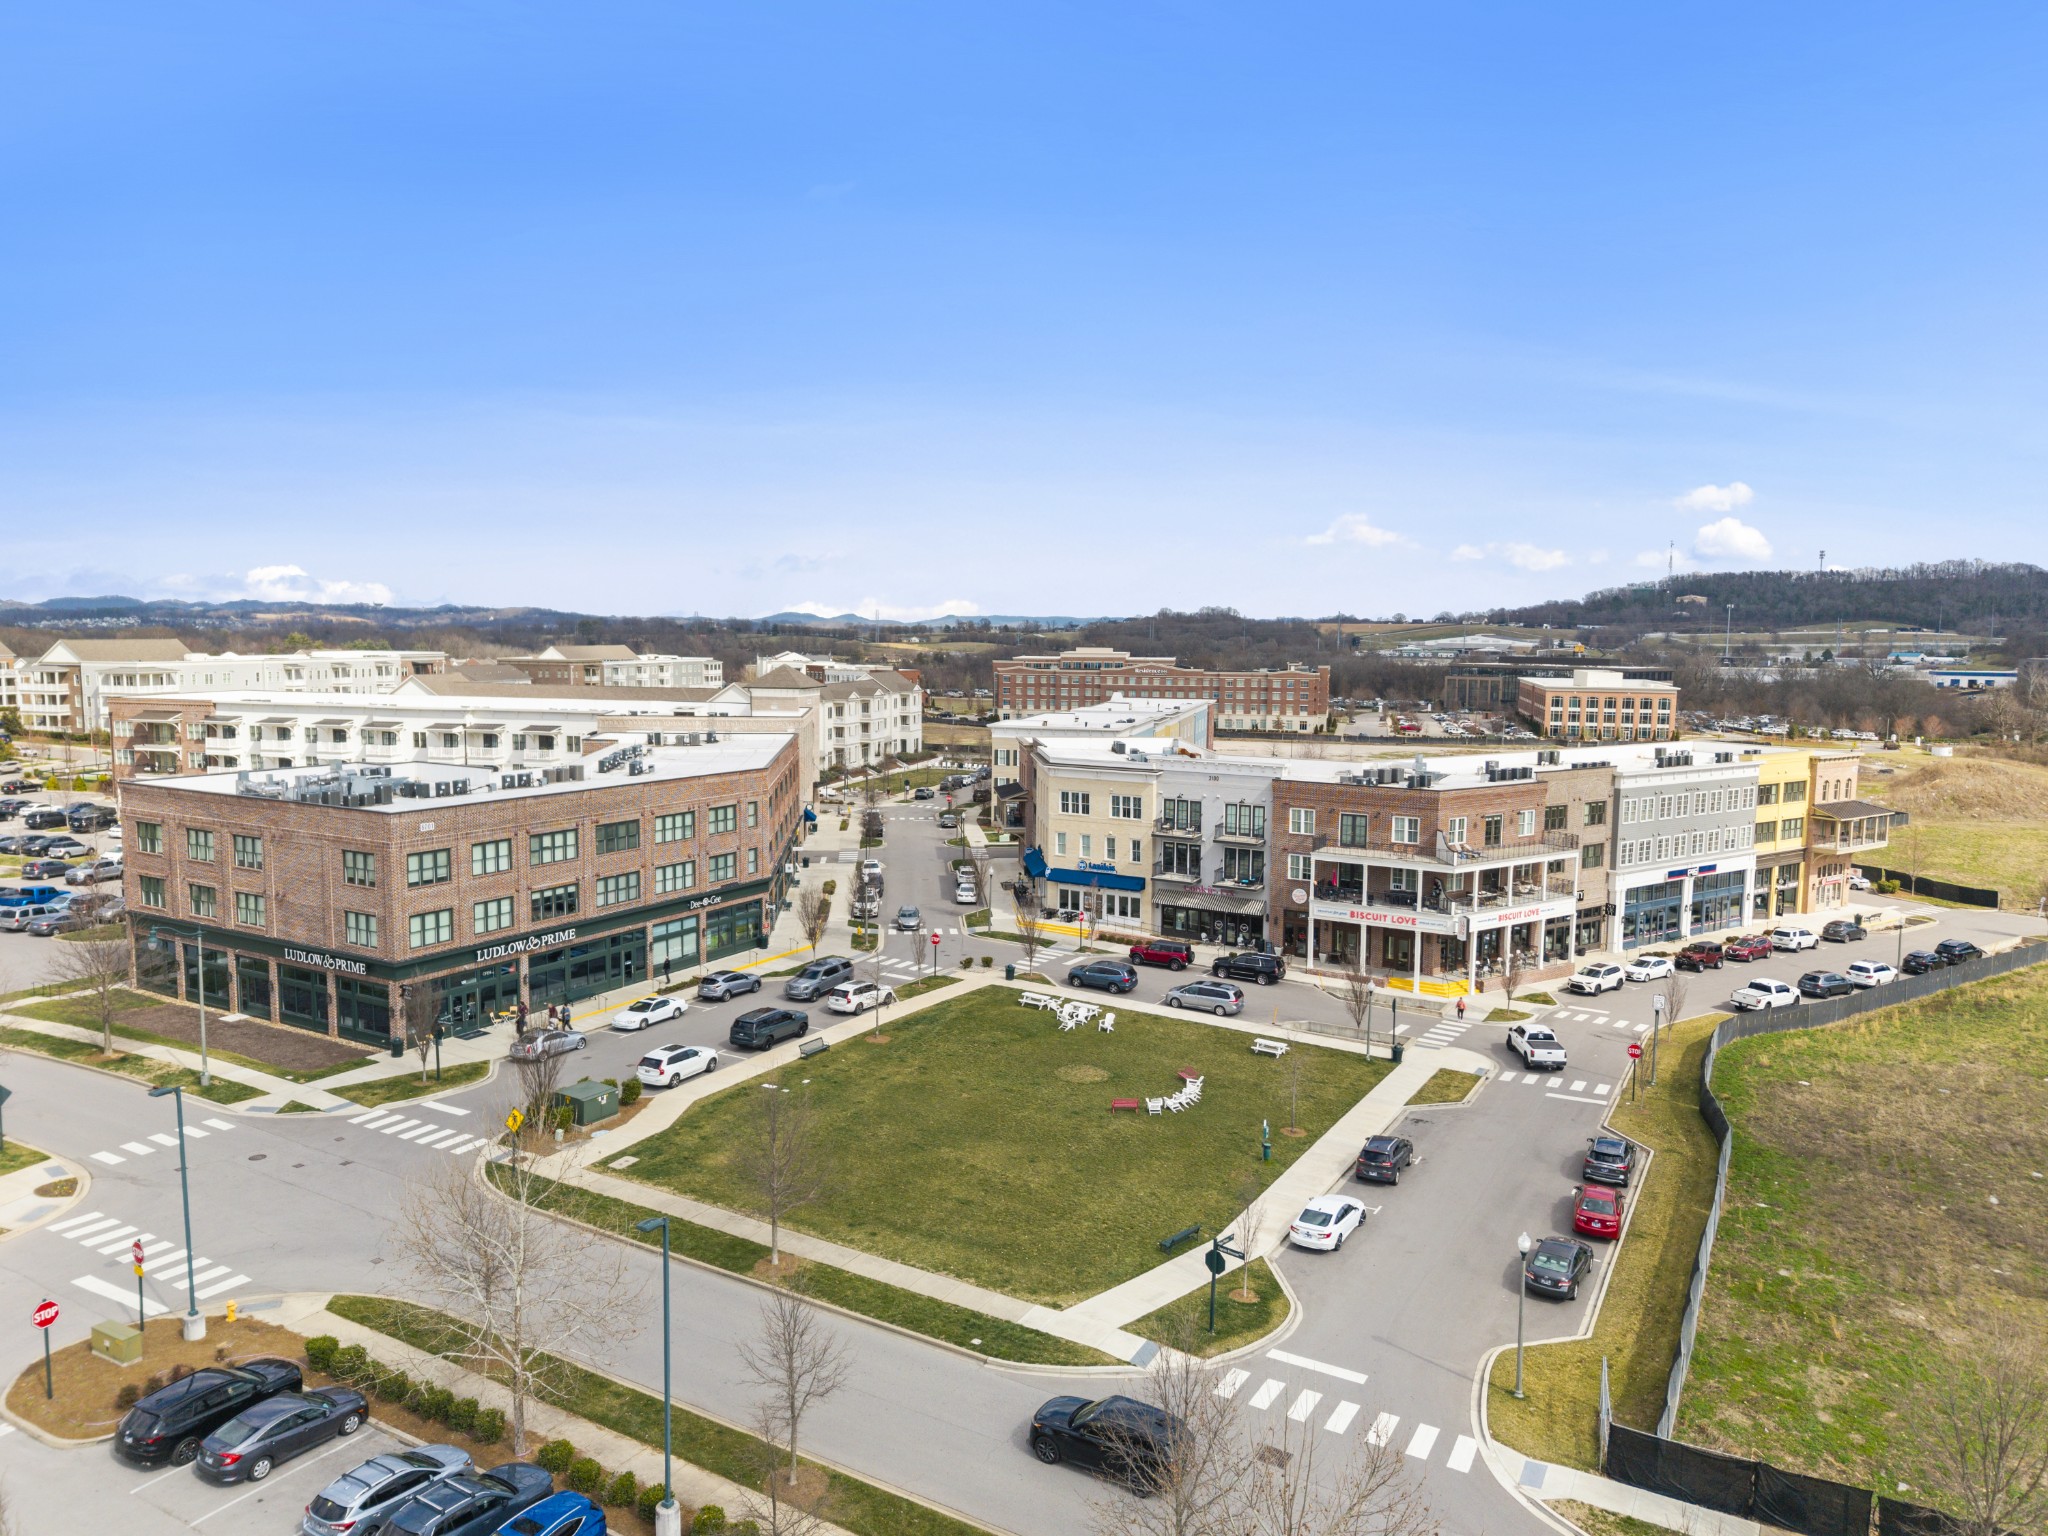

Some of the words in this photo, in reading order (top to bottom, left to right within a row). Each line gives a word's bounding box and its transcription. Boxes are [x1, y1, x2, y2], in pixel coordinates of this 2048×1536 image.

[1349, 910, 1388, 922] BISCUIT
[1391, 915, 1417, 926] LOVE
[1498, 911, 1523, 922] BISCUIT
[1524, 908, 1541, 918] LOVE
[34, 1306, 59, 1324] STOP
